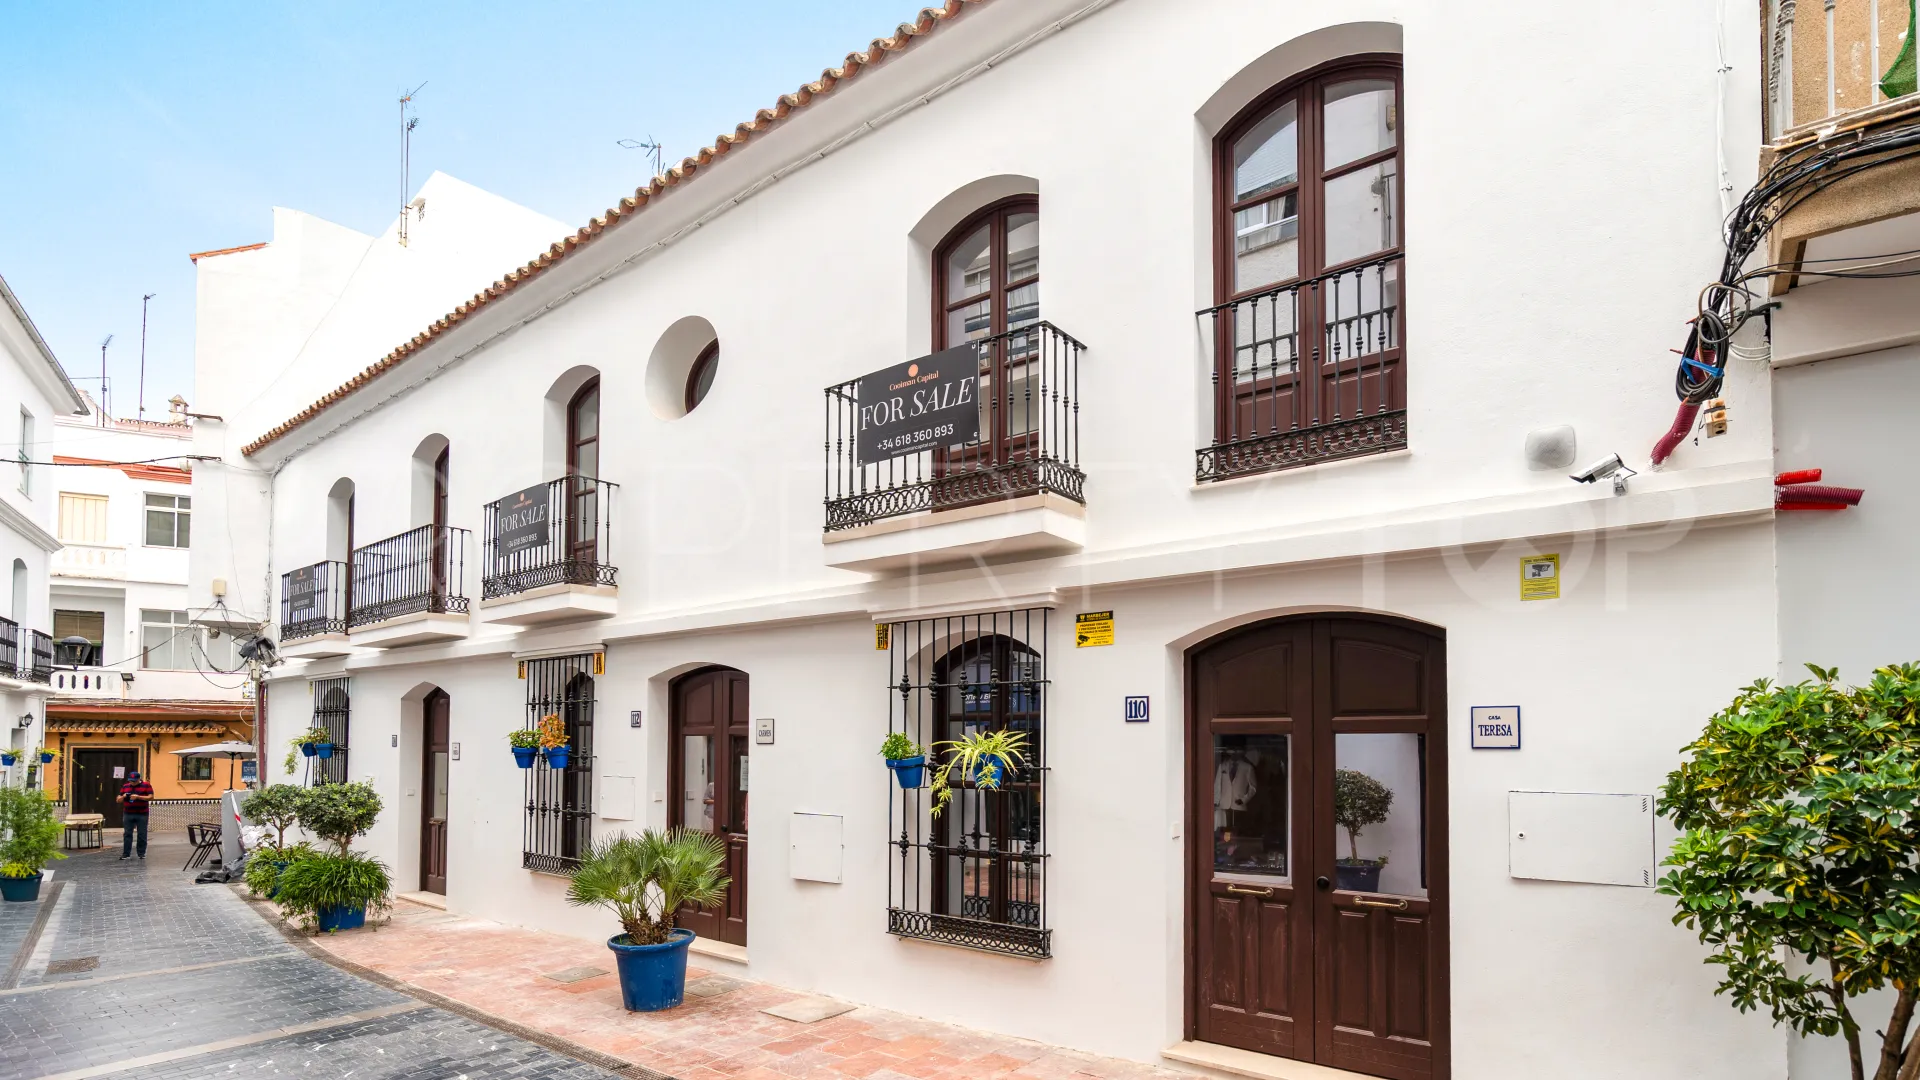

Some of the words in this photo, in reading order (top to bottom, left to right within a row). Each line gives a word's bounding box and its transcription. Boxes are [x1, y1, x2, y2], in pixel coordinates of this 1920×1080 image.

[889, 379, 916, 391] Coolman
[916, 370, 939, 383] Capital
[860, 397, 905, 431] FOR
[909, 376, 975, 417] SALE
[877, 440, 894, 451] +34
[895, 433, 911, 447] 618
[913, 428, 932, 443] 360
[934, 423, 954, 437] 893
[500, 514, 518, 534] FOR
[520, 504, 546, 527] SALE
[1128, 700, 1146, 718] 110
[1478, 724, 1513, 737] TERESA
